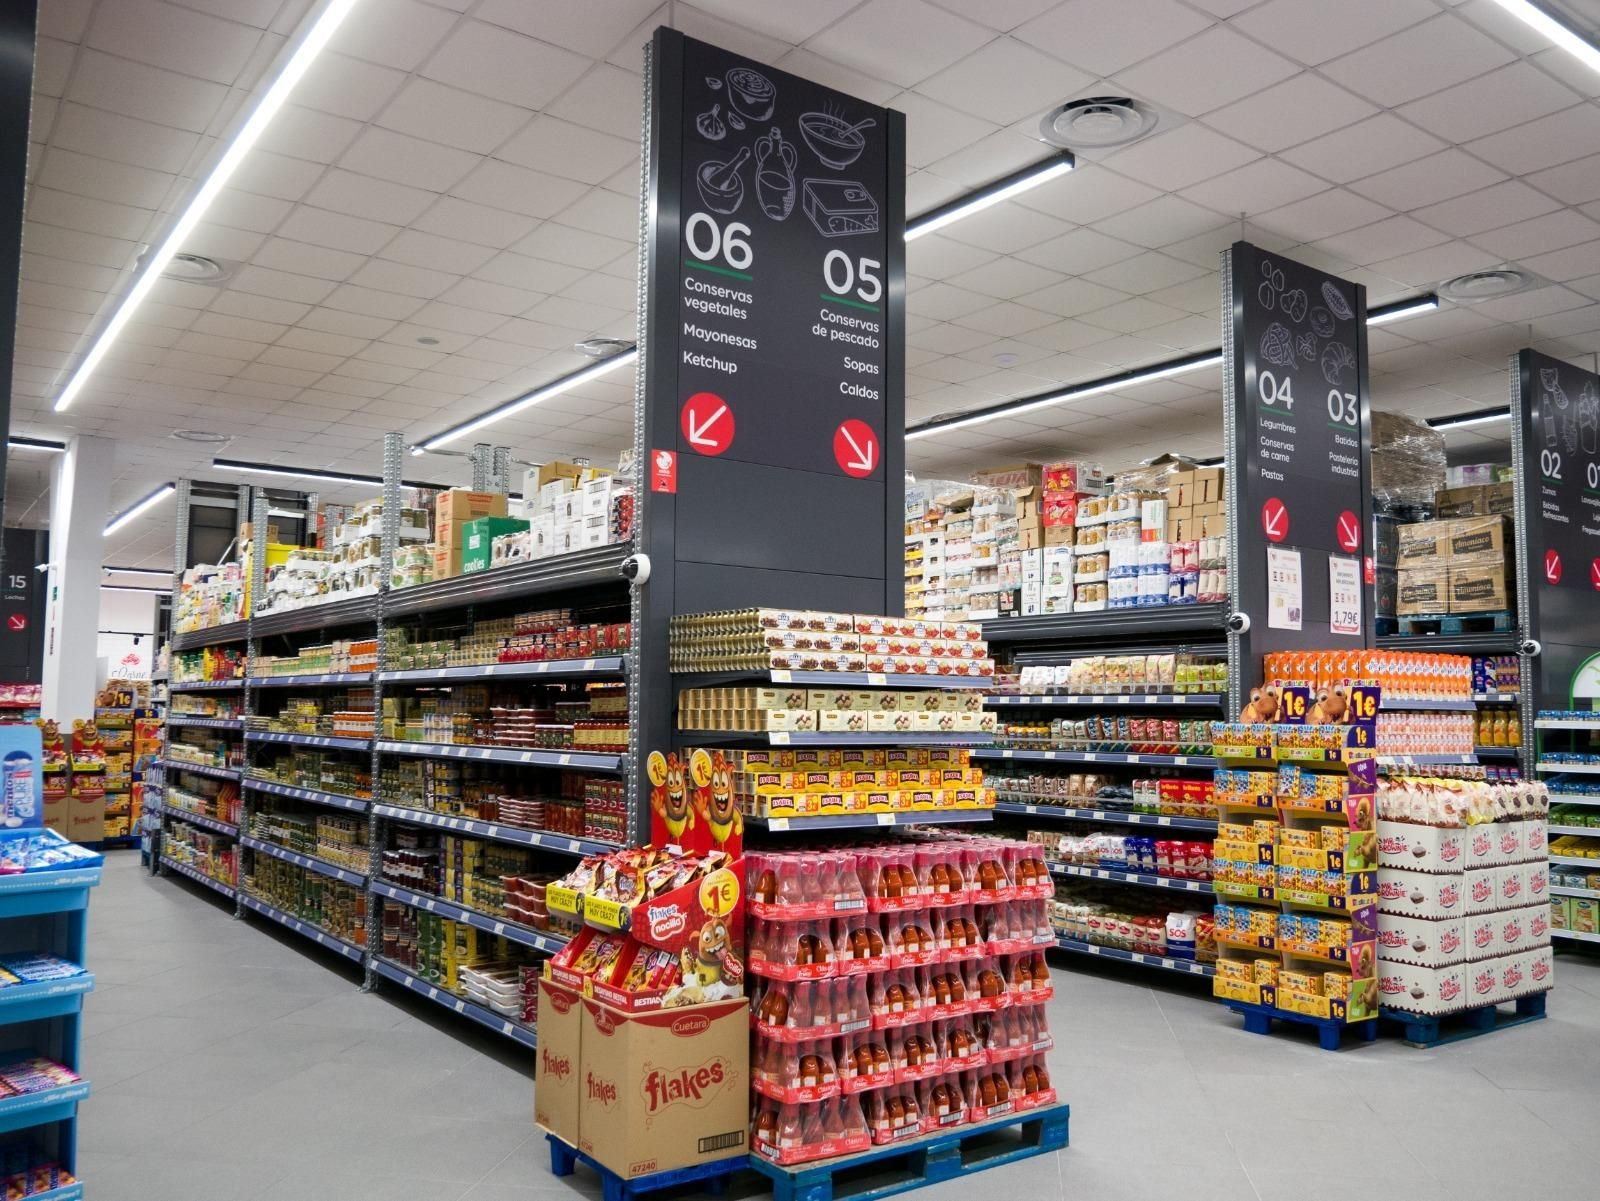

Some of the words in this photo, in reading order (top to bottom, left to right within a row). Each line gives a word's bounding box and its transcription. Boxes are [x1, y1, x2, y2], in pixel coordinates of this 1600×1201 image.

[685, 212, 753, 270] 06
[824, 250, 881, 302] 05
[685, 277, 752, 303] Conservas
[684, 297, 747, 320] vegetales
[820, 309, 879, 332] Conservas
[684, 323, 757, 349] Mayonesas
[812, 324, 827, 337] de
[831, 327, 879, 348] pescado
[684, 351, 737, 374] Ketchup
[844, 357, 879, 374] Sopas
[840, 382, 879, 400] Caldos
[1259, 371, 1293, 409] 04
[1328, 389, 1357, 426] 03
[1260, 417, 1296, 433] Legumbres
[1261, 436, 1294, 451] Conservas
[1335, 435, 1358, 447] Batidos
[1261, 449, 1269, 458] de
[1271, 452, 1289, 462] carne
[1541, 449, 1561, 479] 02
[1262, 469, 1284, 481] Pastas
[1332, 464, 1358, 477] industrial
[464, 558, 484, 572] cookies
[9, 575, 26, 588] 15
[1335, 611, 1358, 624] 1,79€
[1284, 691, 1304, 715] 1€
[1353, 691, 1375, 716] 1€
[1356, 727, 1367, 744] 1€
[809, 775, 828, 783] ISABEL
[7, 772, 15, 818] mentos
[773, 799, 793, 807] ISABEL
[822, 797, 842, 805] ISABEL
[560, 898, 572, 907] CRAZY
[708, 884, 731, 913] 1€
[590, 908, 599, 916] MUY
[600, 911, 614, 920] CRAZY
[650, 906, 676, 920] flakes
[655, 917, 681, 933] nocilla
[1169, 928, 1186, 937] SOS
[543, 1049, 569, 1079] flakes
[588, 1072, 616, 1106] flakes
[645, 1061, 724, 1111] flakes
[632, 1162, 655, 1173] 47240
